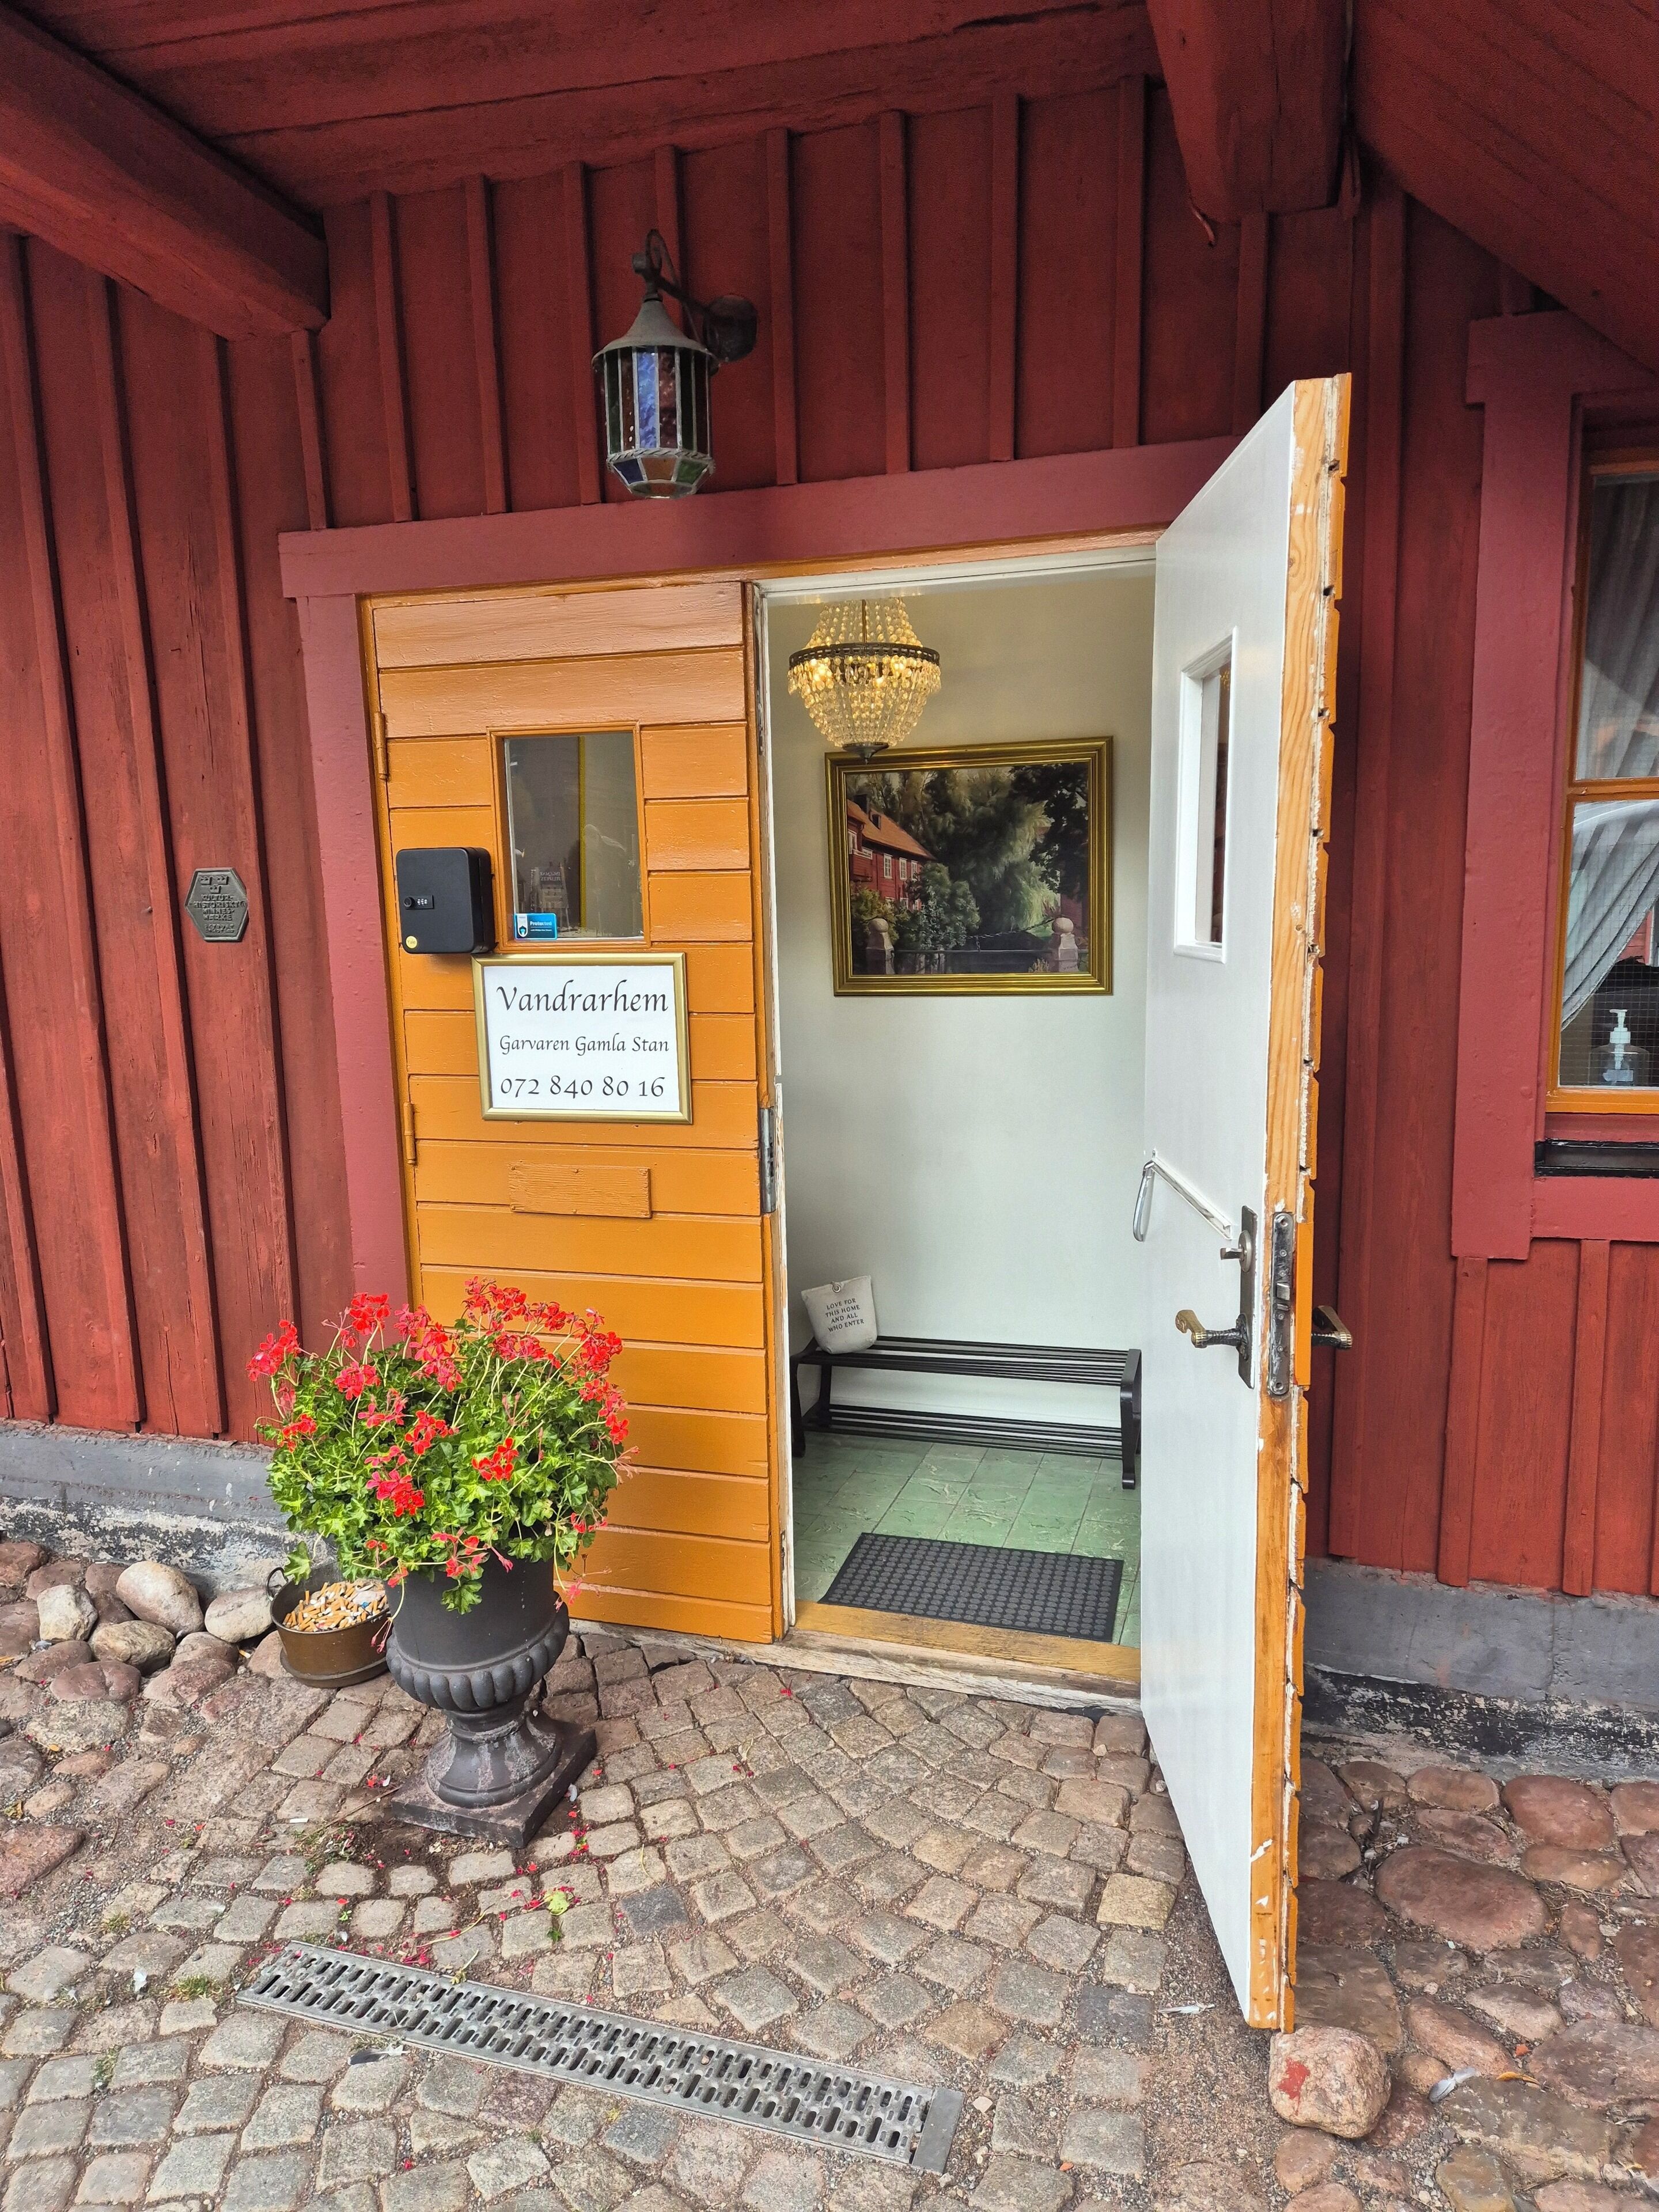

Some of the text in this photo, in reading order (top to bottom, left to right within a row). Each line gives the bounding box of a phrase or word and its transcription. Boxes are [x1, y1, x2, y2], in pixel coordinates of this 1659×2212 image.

[496, 979, 669, 1012] Vandrarhem
[499, 1033, 669, 1056] Garvaren Gamla Stan
[501, 1075, 665, 1099] 072 840 80 16
[825, 1305, 860, 1317] THIS HOME
[827, 1301, 842, 1310] LOVE
[828, 1319, 864, 1332] WHO ENTER
[831, 1316, 844, 1324] AND
